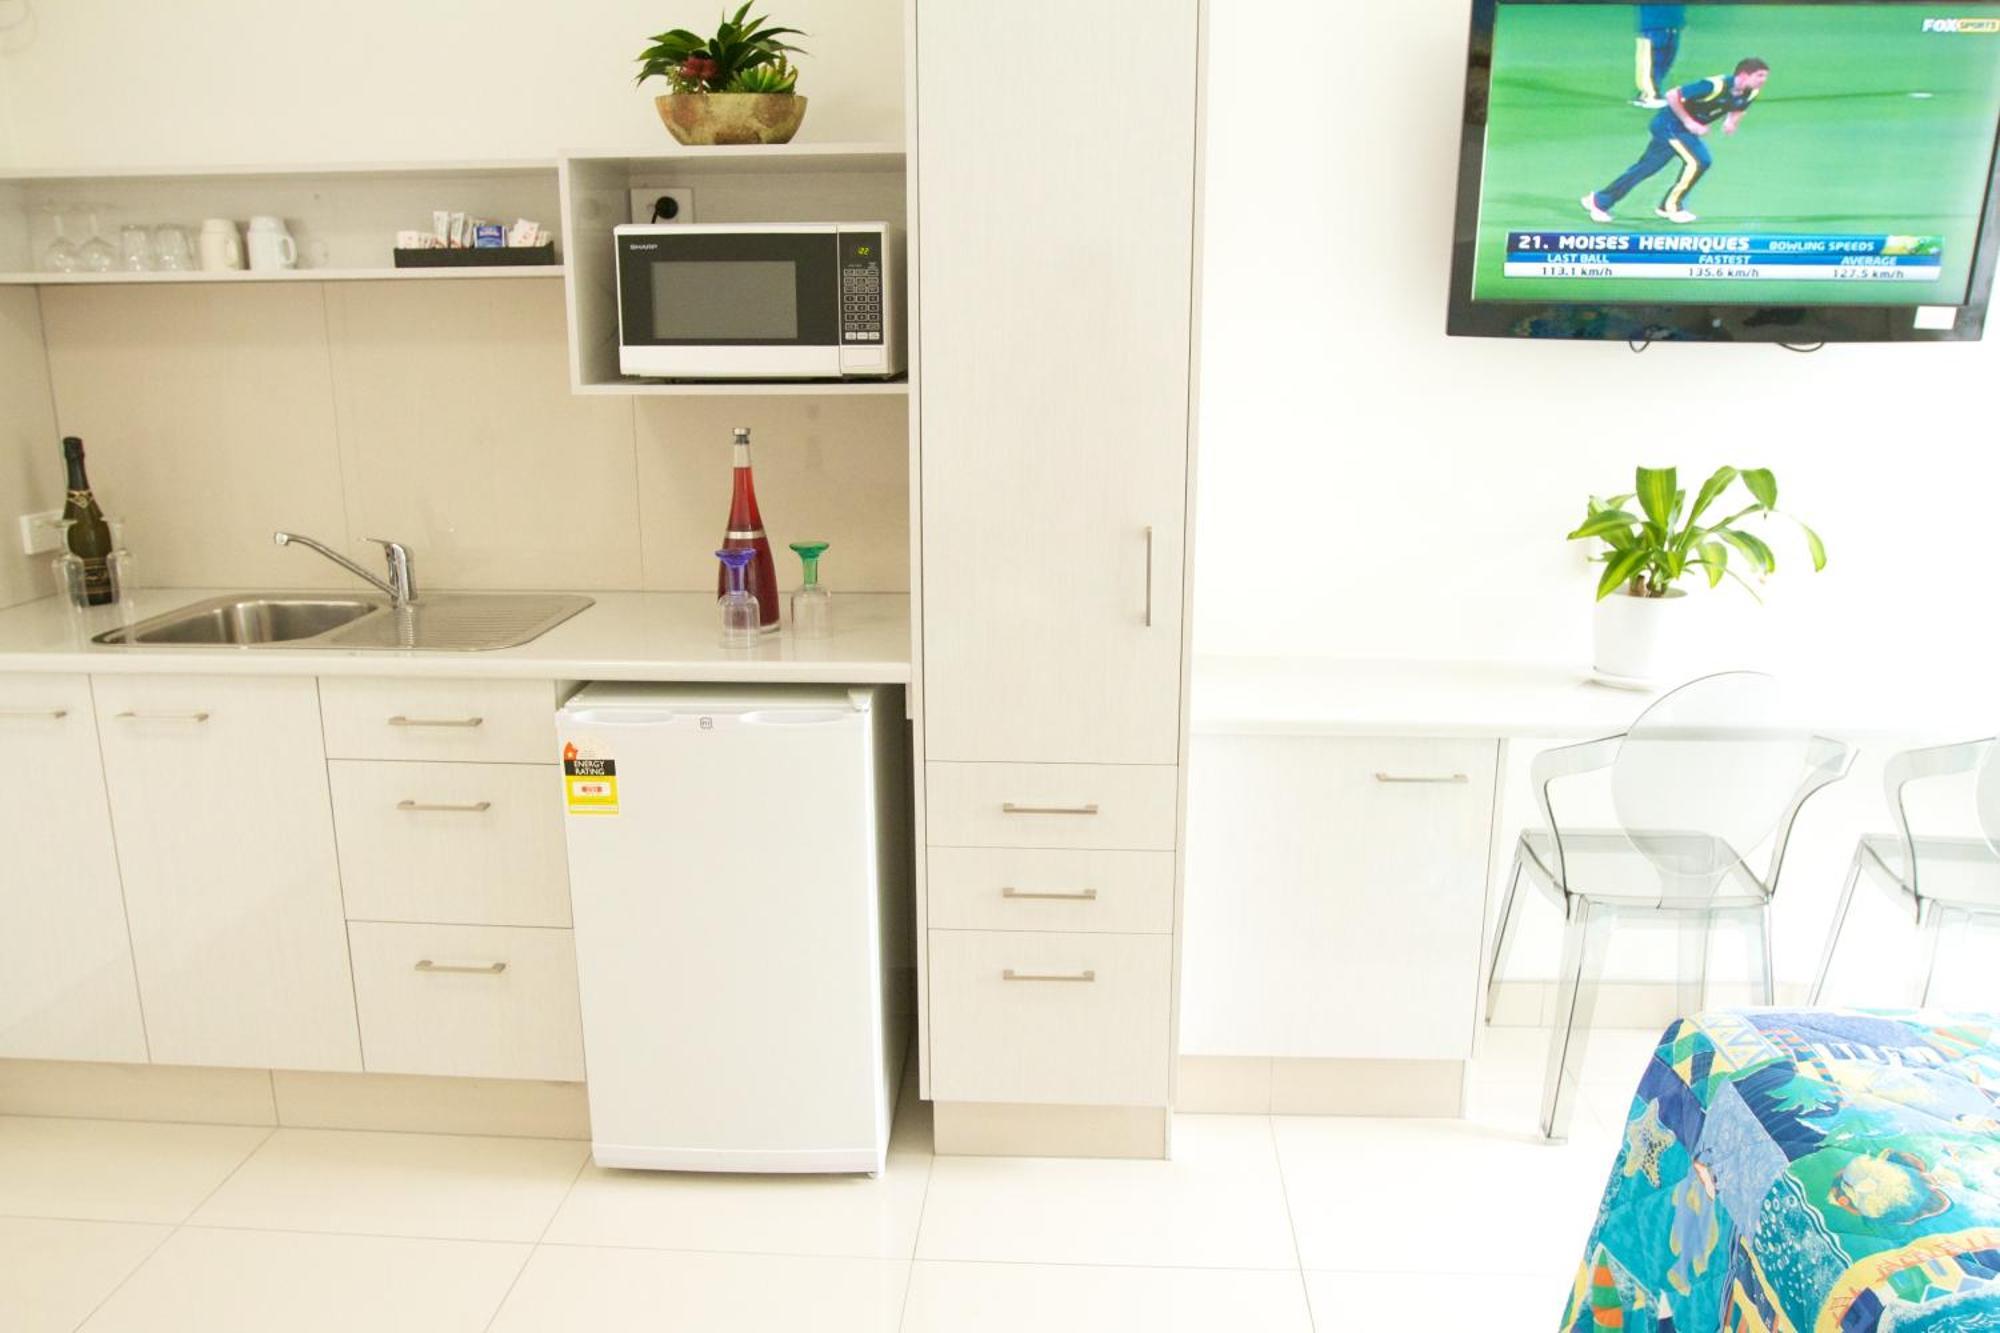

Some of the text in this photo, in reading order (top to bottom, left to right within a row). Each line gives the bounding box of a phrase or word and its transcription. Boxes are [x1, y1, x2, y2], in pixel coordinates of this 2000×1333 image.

[1922, 18, 1957, 32] FOX
[629, 243, 658, 251] SHARP
[1518, 235, 1750, 253] 21. MOISES HENRIQUES
[1769, 240, 1875, 251] BOWLING SPEEDS
[1547, 253, 1610, 264] LAST BALL
[1699, 254, 1752, 265] FASTEST
[1841, 255, 1898, 266] AVERAGE
[1581, 266, 1613, 276] km/h
[1727, 267, 1759, 277] km/h
[1872, 269, 1904, 278] km/h
[574, 760, 605, 768] ENERGY
[575, 768, 605, 776] RATING
